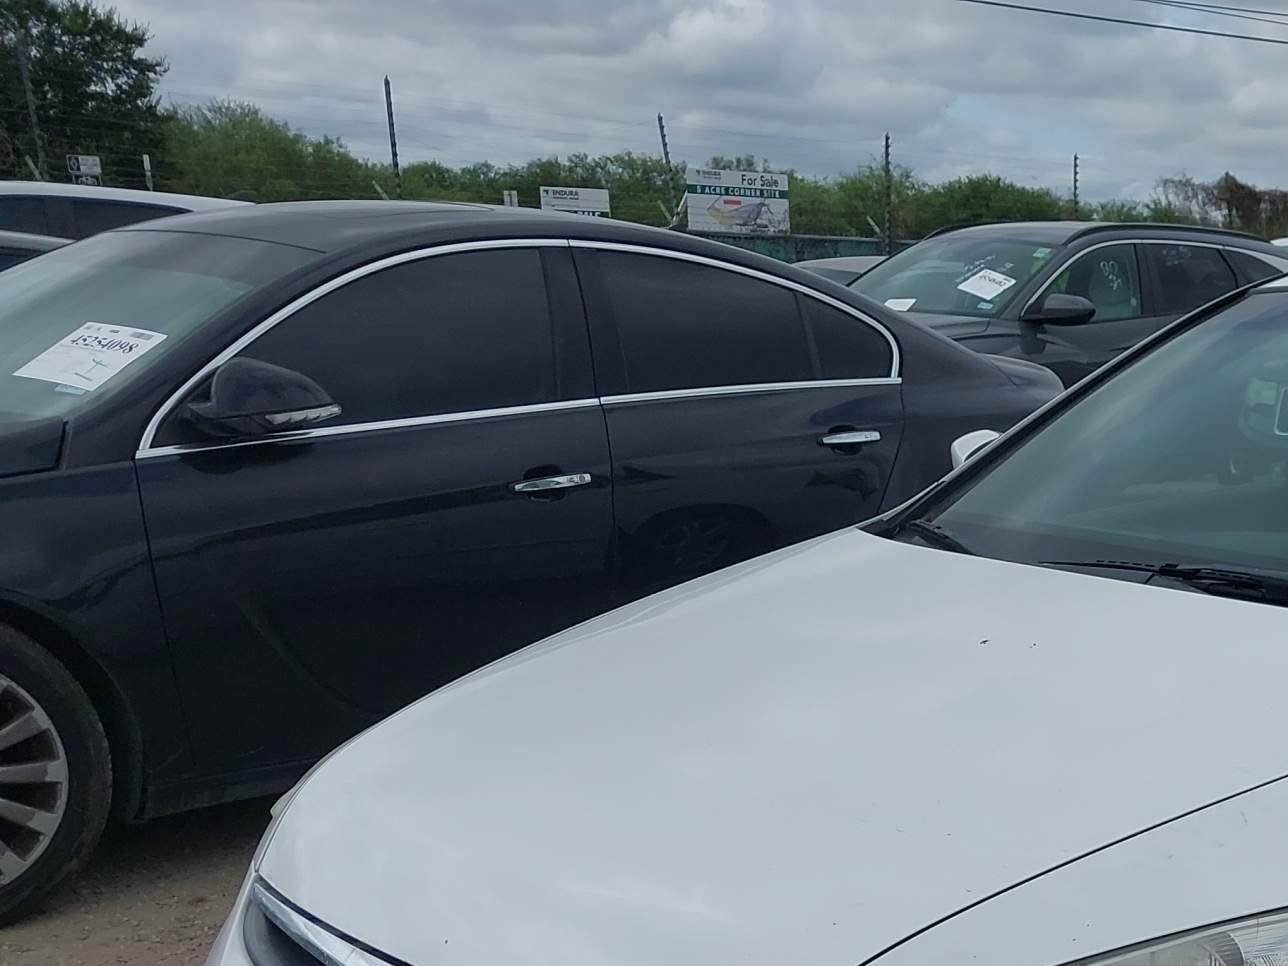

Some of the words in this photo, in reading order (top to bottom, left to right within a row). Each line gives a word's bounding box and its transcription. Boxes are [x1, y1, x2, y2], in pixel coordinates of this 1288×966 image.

[741, 174, 758, 186] For
[760, 175, 779, 188] Sale
[704, 186, 725, 195] ACRE
[728, 187, 760, 197] CORNER
[763, 189, 780, 198] SITE
